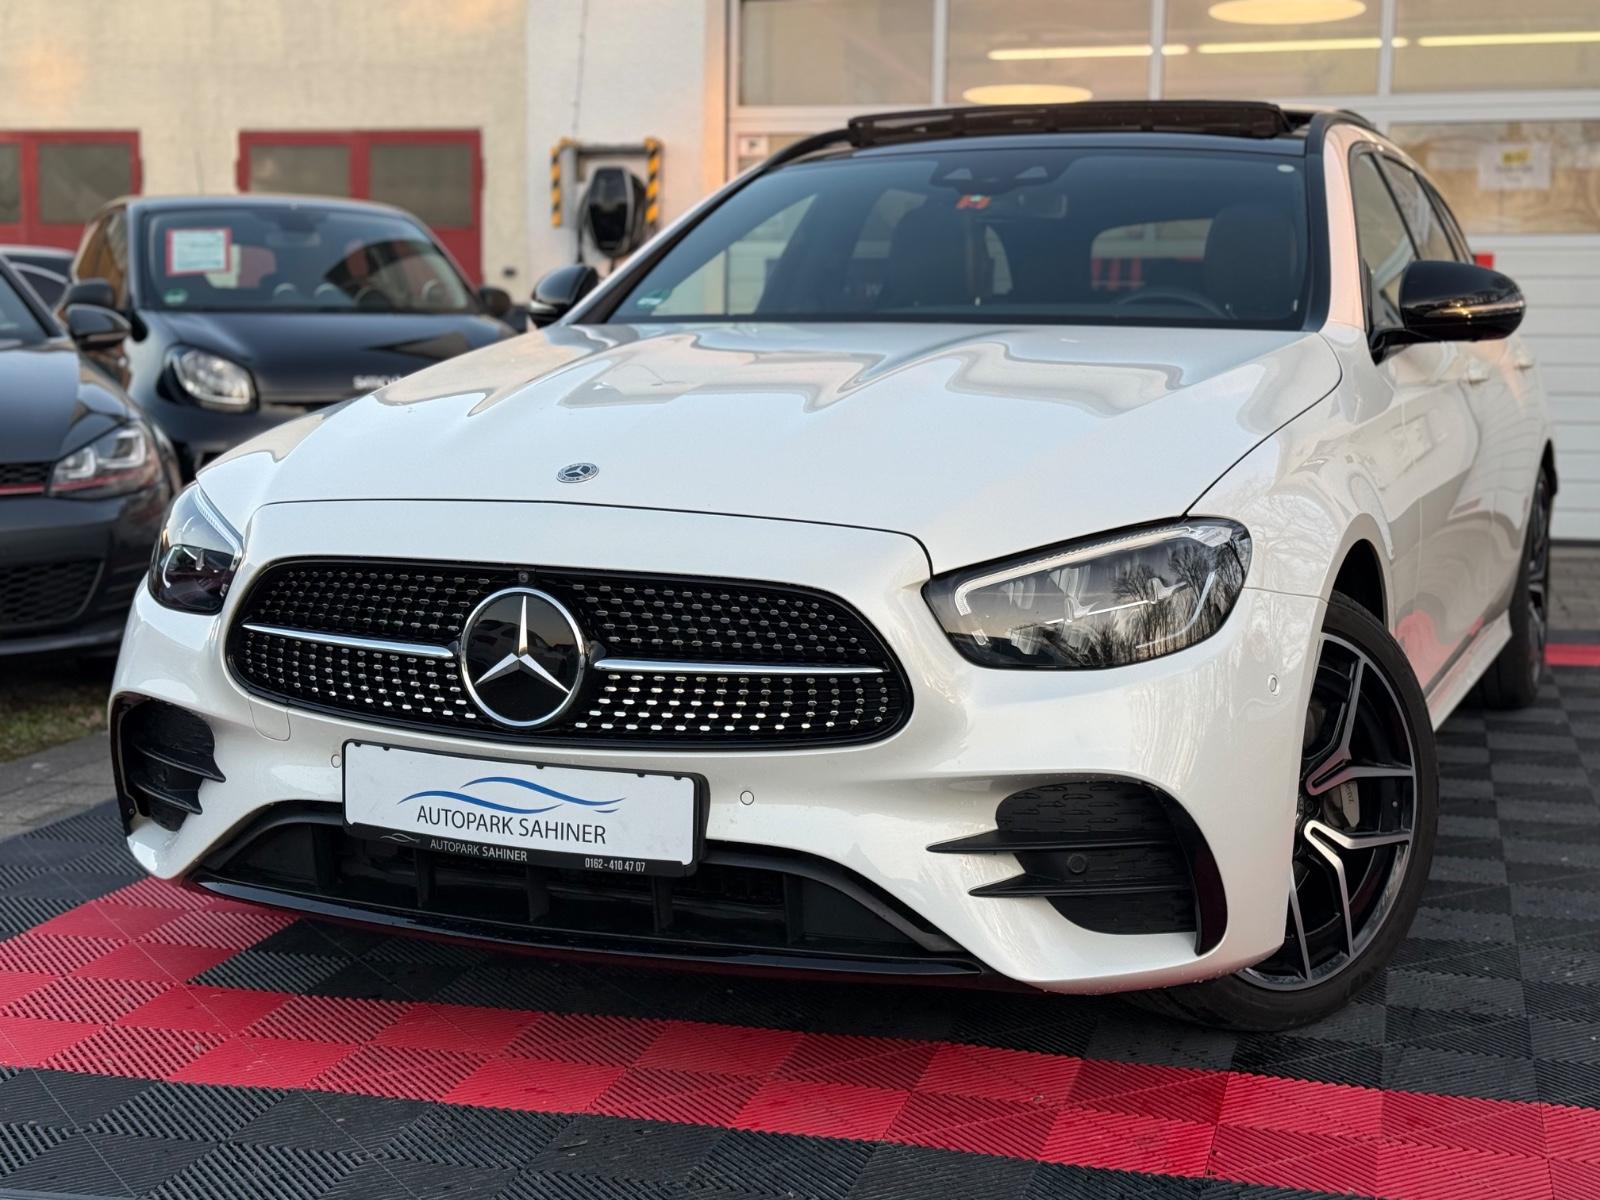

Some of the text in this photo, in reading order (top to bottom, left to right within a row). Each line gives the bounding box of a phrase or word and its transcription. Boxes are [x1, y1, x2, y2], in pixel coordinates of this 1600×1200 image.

[416, 805, 606, 845] AUTOPARK SAHINER
[430, 839, 528, 862] AUTOPARK SAHINER
[624, 861, 634, 872] 47
[635, 862, 646, 873] 07
